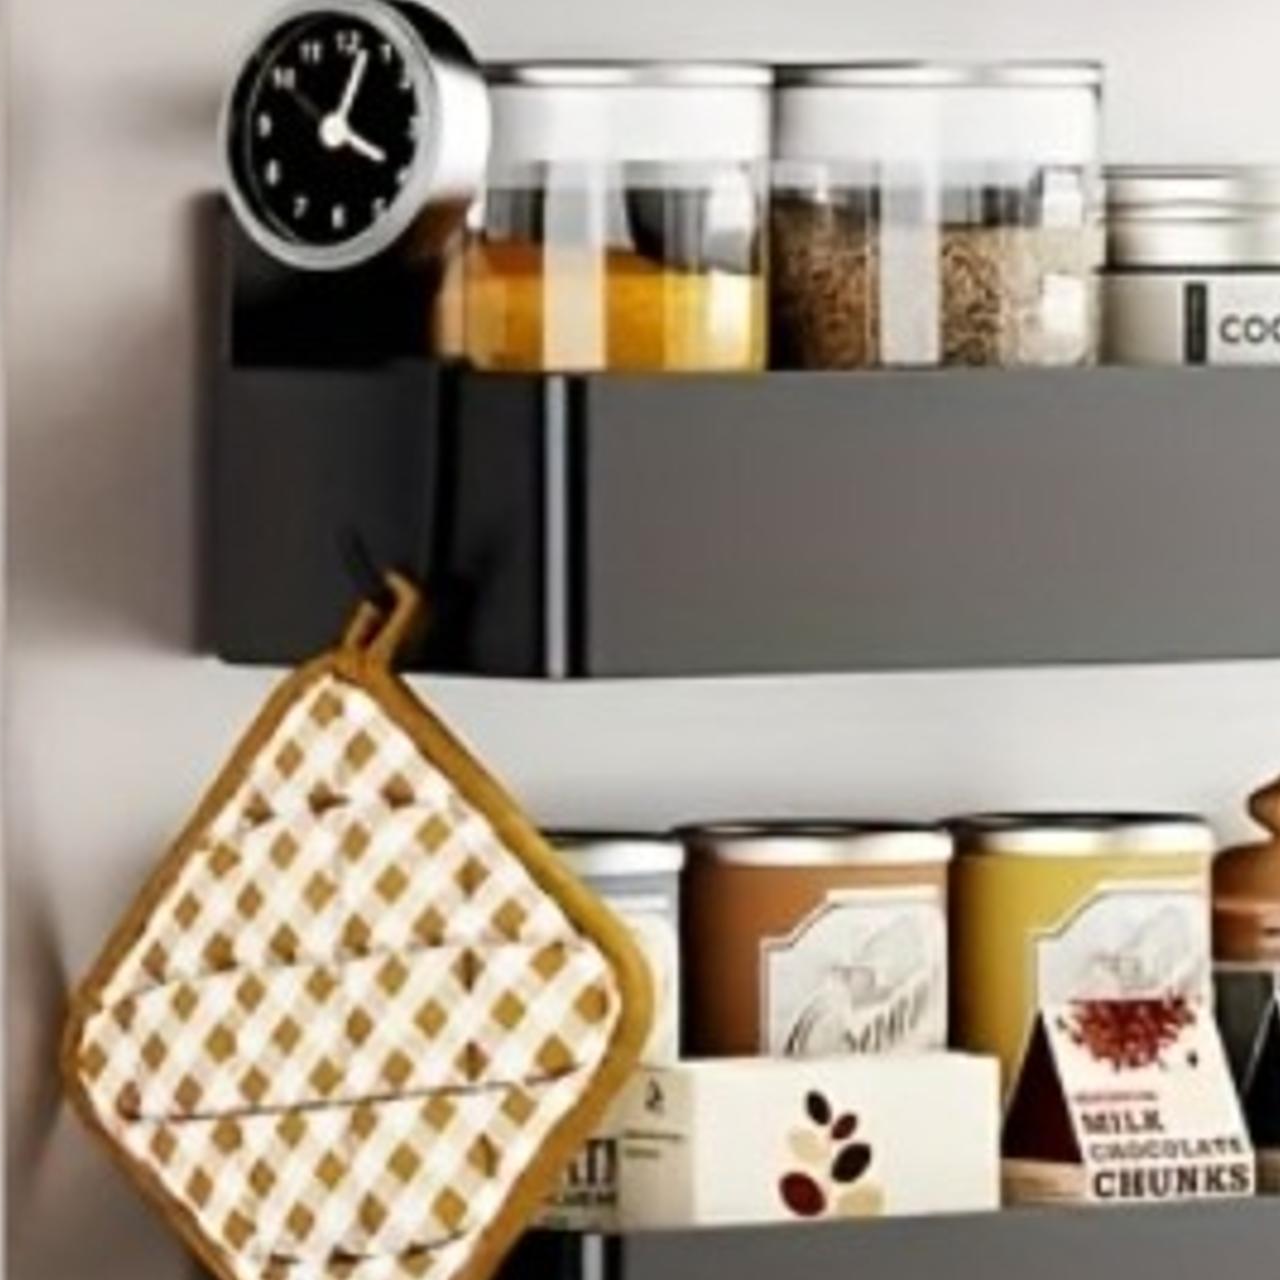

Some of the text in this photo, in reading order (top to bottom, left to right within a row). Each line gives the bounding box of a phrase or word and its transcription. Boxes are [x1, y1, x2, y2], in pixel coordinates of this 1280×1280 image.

[1082, 1110, 1164, 1135] MILK
[1090, 1138, 1243, 1160] CHOCOLATE
[1094, 1164, 1250, 1197] CHUNKS
